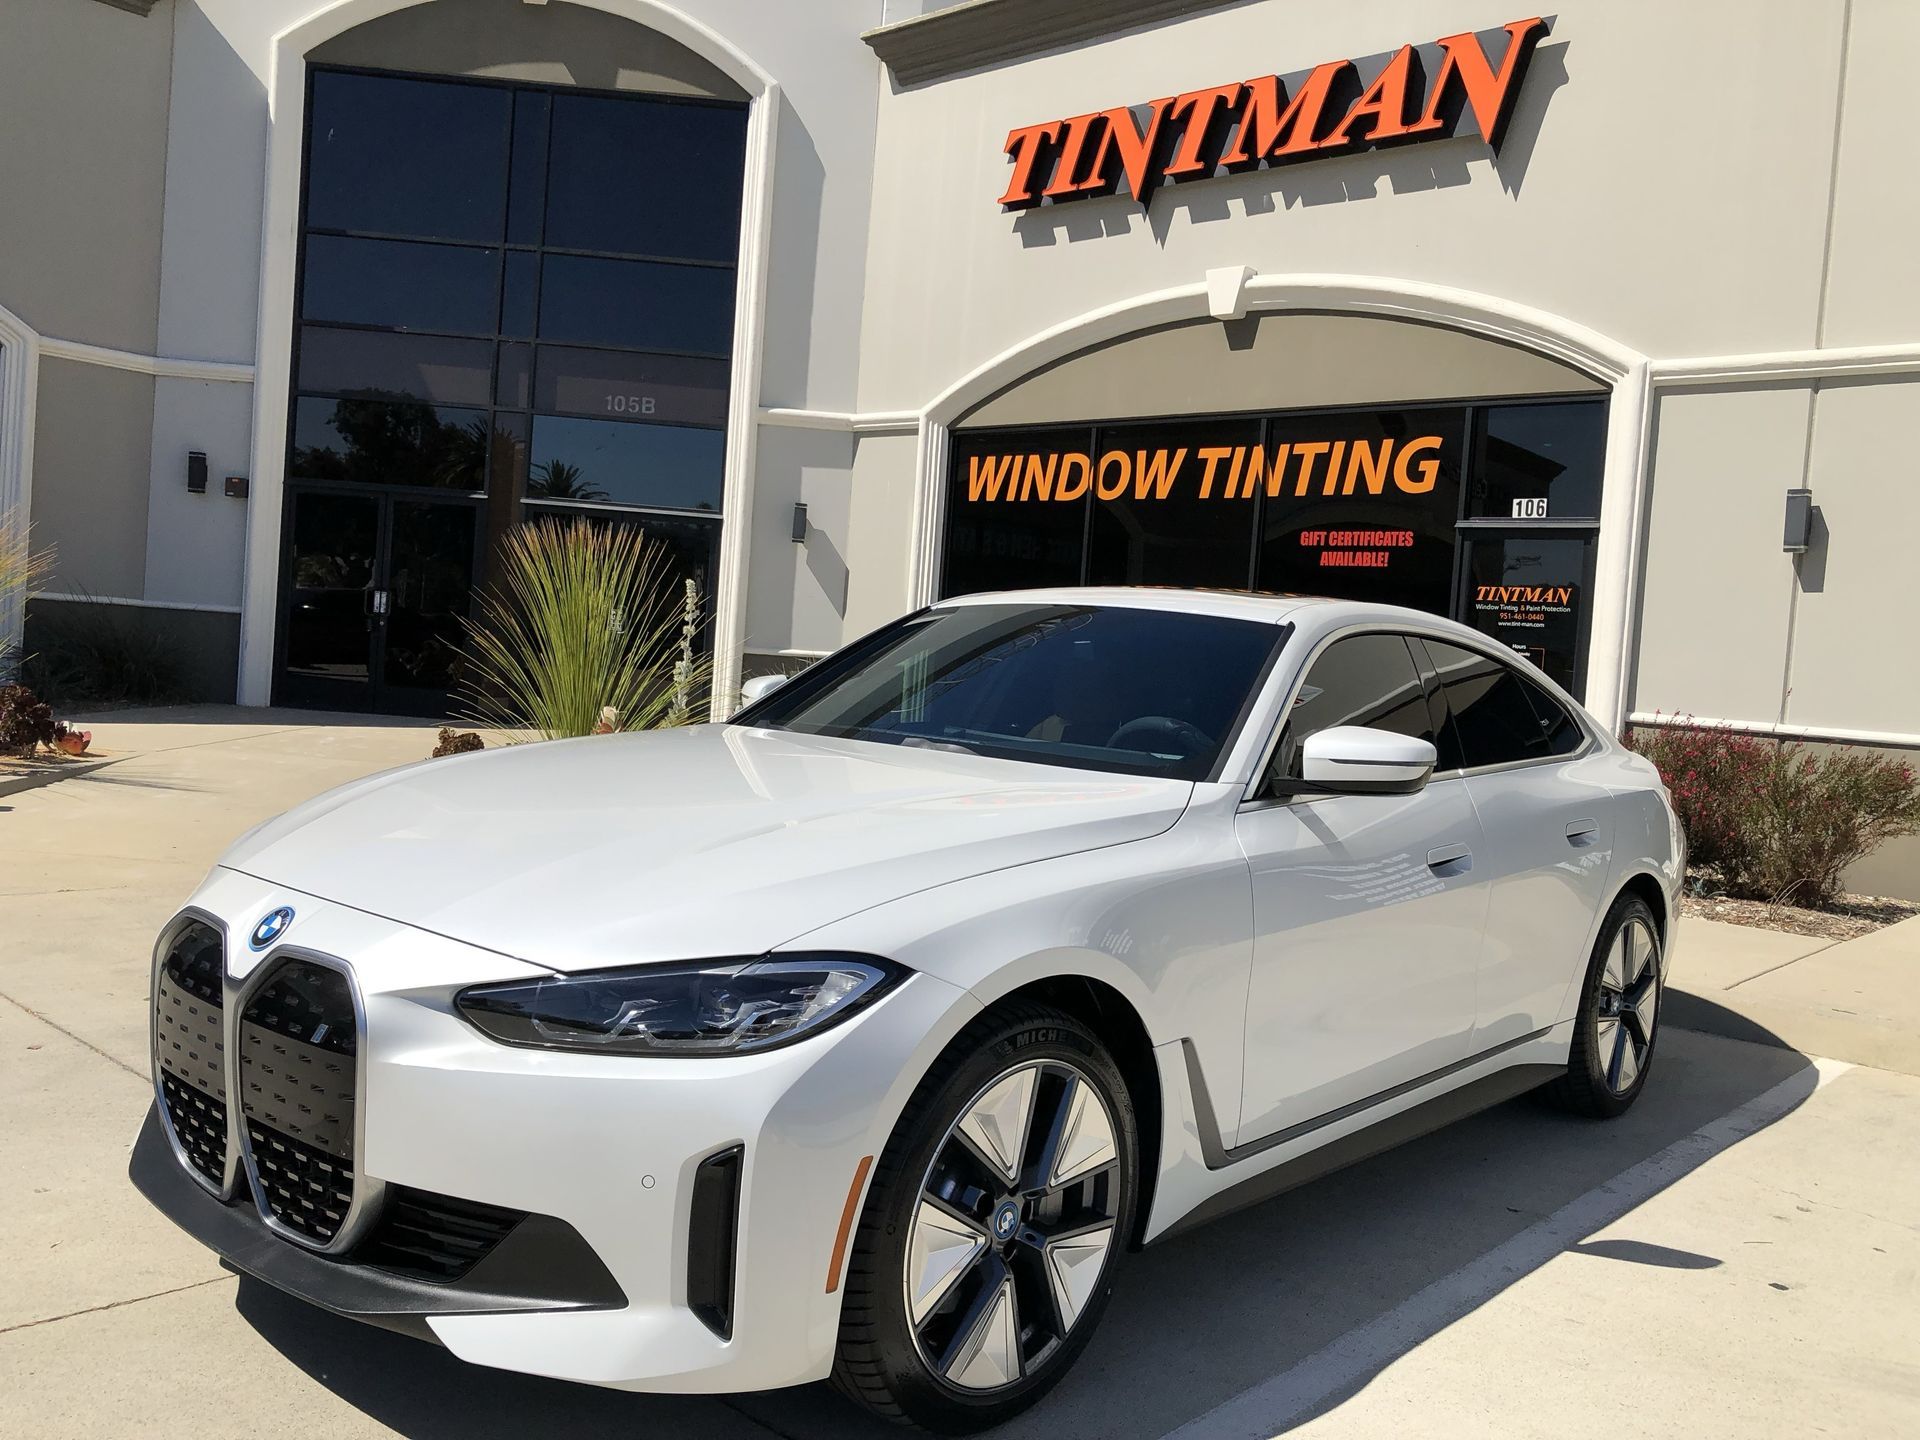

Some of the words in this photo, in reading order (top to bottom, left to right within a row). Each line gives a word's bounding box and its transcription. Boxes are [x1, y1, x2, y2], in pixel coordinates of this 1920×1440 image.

[997, 17, 1551, 207] TINTMAN
[605, 395, 655, 413] 105B
[968, 448, 1188, 502] WINDOW
[1197, 436, 1443, 499] TINTING
[1515, 499, 1545, 517] 106
[1300, 531, 1327, 546] GIFT
[1328, 531, 1414, 547] CERTIFICATES
[1320, 551, 1390, 567] AVAILABLE!
[1476, 586, 1572, 606] TINTMAN
[1476, 603, 1499, 611] Window
[1500, 604, 1519, 613] Tinting
[1541, 605, 1571, 613] Protection
[1500, 613, 1545, 621] 951-461-0440
